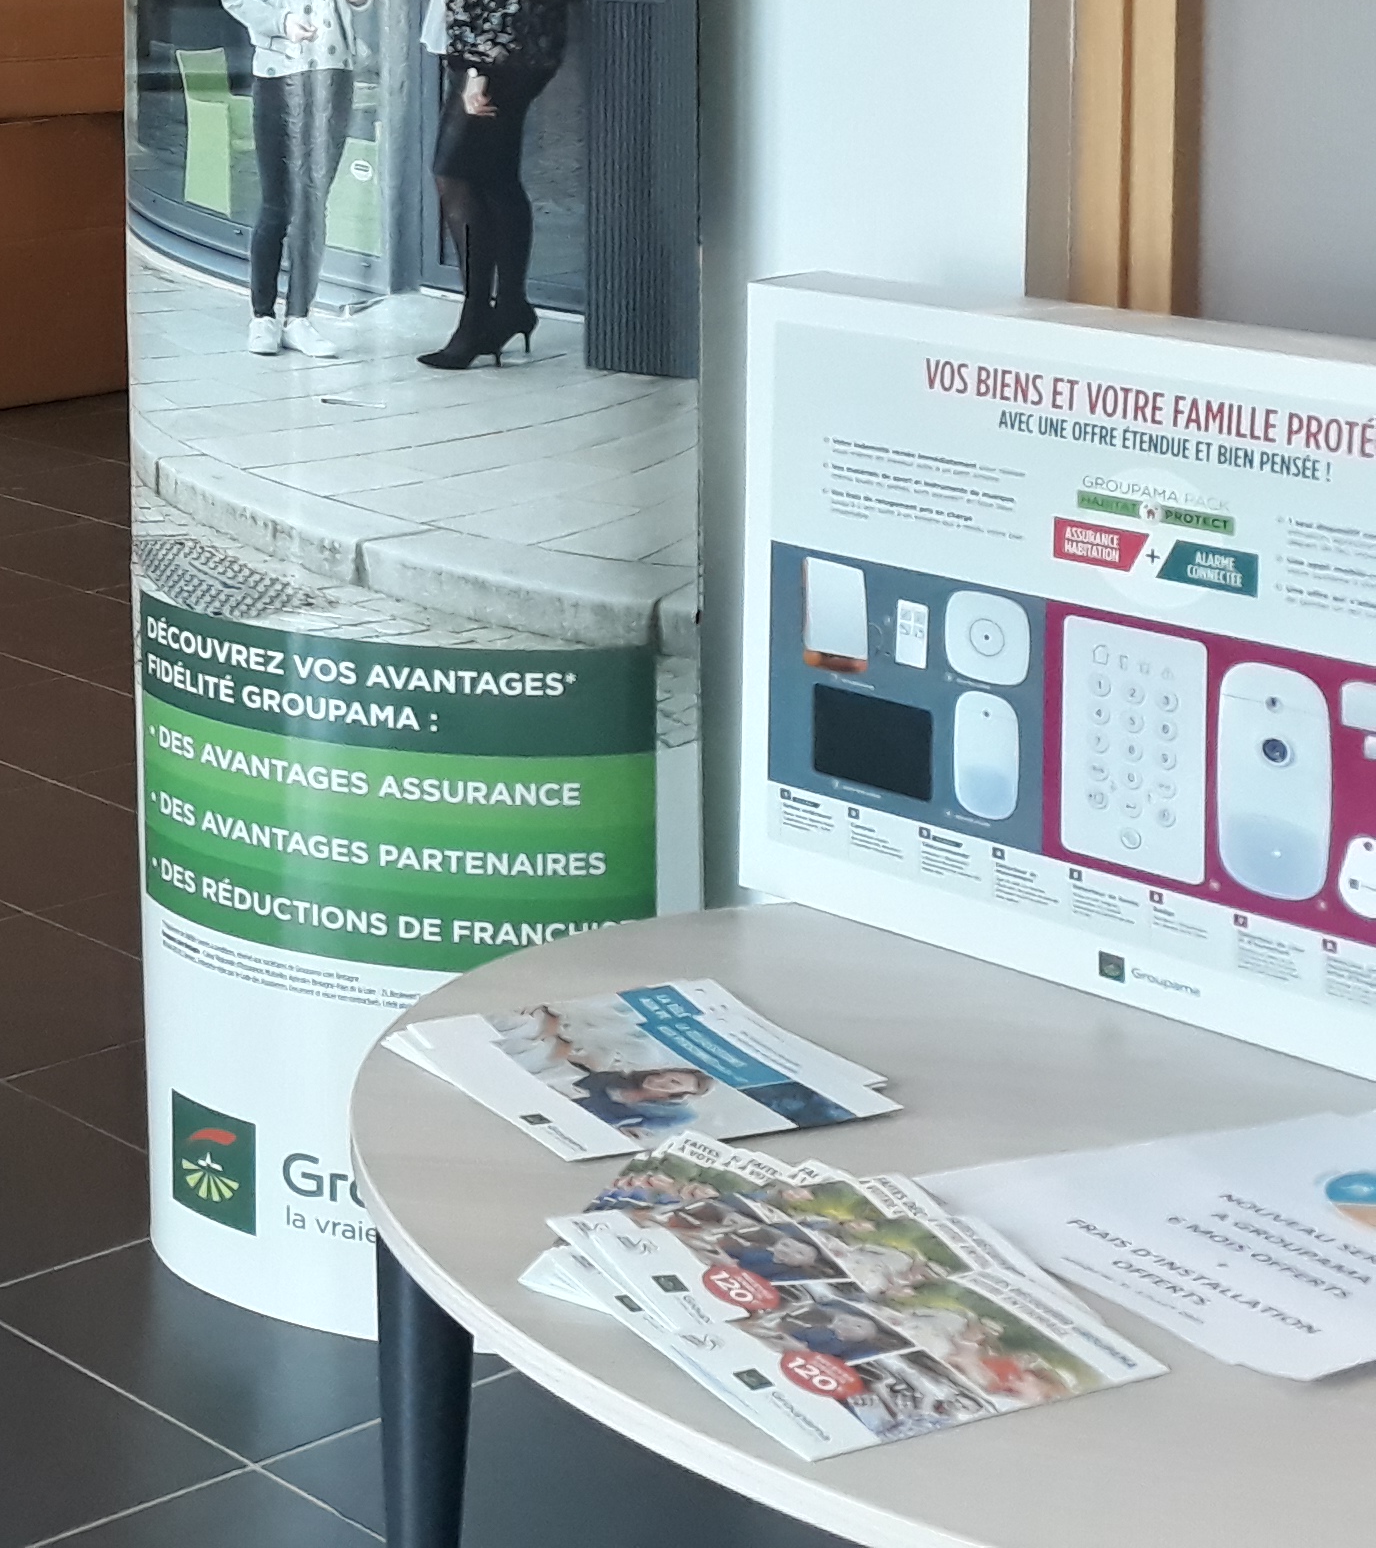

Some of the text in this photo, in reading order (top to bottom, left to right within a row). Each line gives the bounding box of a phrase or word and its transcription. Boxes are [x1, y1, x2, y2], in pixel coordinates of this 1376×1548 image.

[925, 357, 969, 394] VOS
[976, 365, 1044, 406] BIENS
[1051, 377, 1080, 411] ET
[1086, 381, 1164, 425] VOTRE
[1172, 395, 1277, 443] FAMILLE
[998, 409, 1034, 434] AVEC
[1037, 416, 1068, 440] UNE
[1072, 421, 1118, 448] OFFRE
[1122, 427, 1191, 460] ÉTENDUE
[1194, 441, 1213, 464] ET
[1217, 444, 1255, 471] BIEN
[1260, 451, 1322, 482] PENSÉE
[1082, 475, 1179, 504] GROUPAMA
[1064, 526, 1120, 549] ASSURANCE
[1165, 509, 1230, 531] PROTECT
[1064, 540, 1120, 563] HABITATION
[1195, 551, 1236, 571] ALARME
[146, 610, 285, 677] DÉCOUVREZ
[293, 653, 357, 686] VOS
[146, 652, 235, 704] FIDÉLITÉ
[241, 684, 421, 732] GROUPAMA
[158, 725, 582, 807] DES AVANTAGES ASSURANCE
[159, 791, 607, 877] DES AVANTAGES PARTENAIRES
[160, 858, 196, 894] DES
[202, 877, 388, 937] RÉDUCTIONS
[398, 917, 442, 943] DE
[285, 1206, 377, 1245] la vraie
[1066, 1217, 1132, 1249] FRAIS
[1234, 1220, 1372, 1284] GROUPAMA
[1250, 1252, 1349, 1299] OFFERTS
[709, 1270, 754, 1303] 120
[1111, 1259, 1211, 1306] OFFERTS
[787, 1357, 838, 1391] 120
